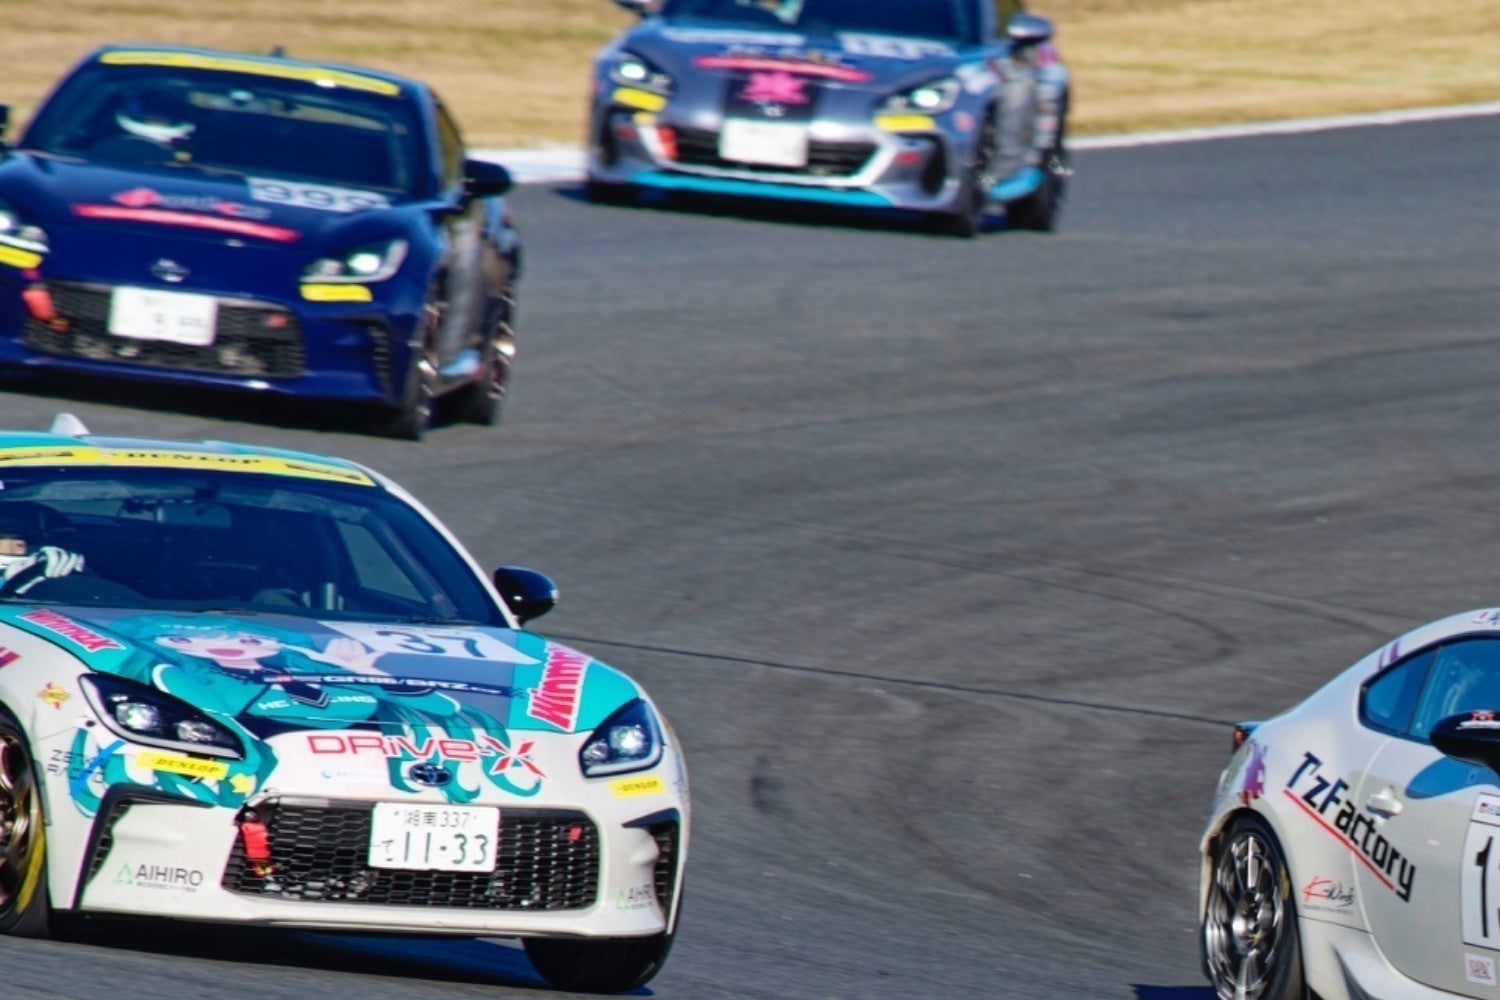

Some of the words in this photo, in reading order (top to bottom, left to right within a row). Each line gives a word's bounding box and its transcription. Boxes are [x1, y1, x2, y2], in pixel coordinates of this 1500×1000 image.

[375, 630, 487, 659] 37
[155, 758, 220, 773] DUNLOP
[405, 810, 437, 828] 湘南
[439, 810, 471, 828] 337
[135, 863, 204, 887] AIHIRO
